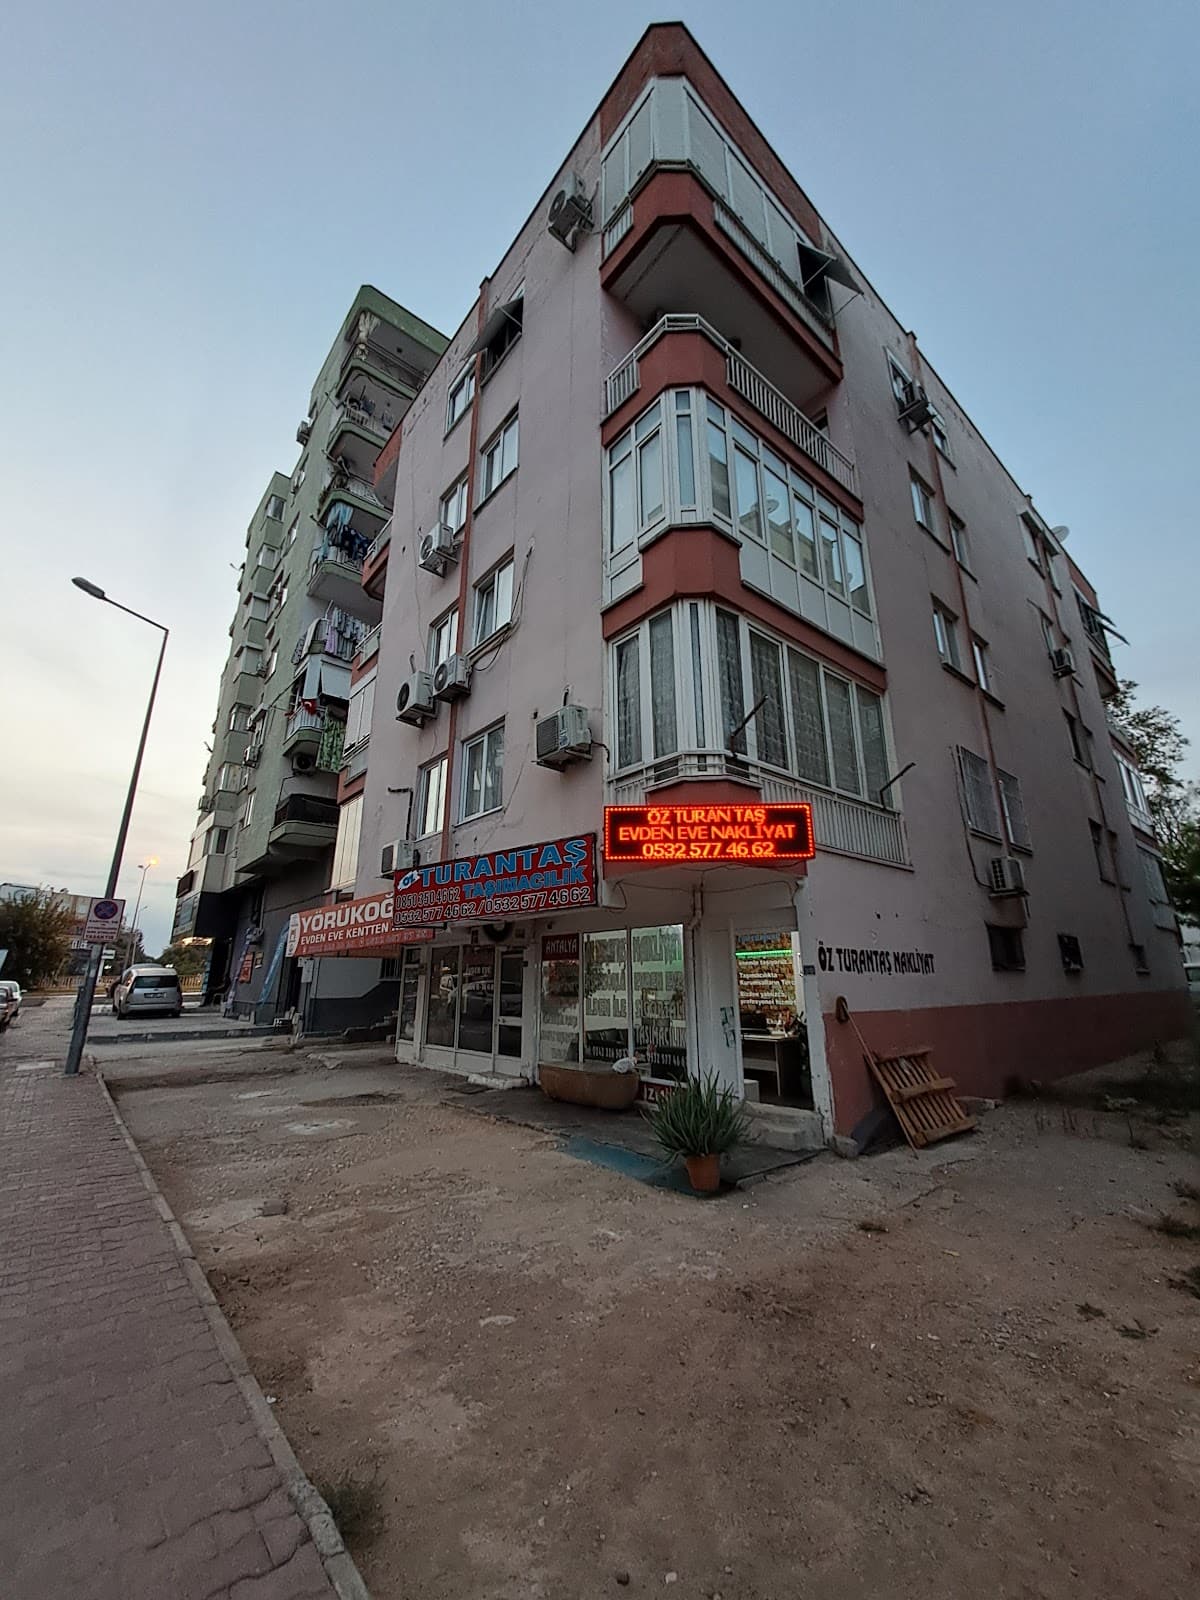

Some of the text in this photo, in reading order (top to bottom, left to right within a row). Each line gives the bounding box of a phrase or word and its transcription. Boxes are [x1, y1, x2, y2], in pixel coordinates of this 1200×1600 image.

[647, 807, 767, 825] ÖZ TURAN TAŞ
[618, 823, 796, 841] EVDEN EVE NAKLİYAT
[642, 841, 775, 858] 0532 577 46 62
[419, 839, 588, 888] TURANTAŞ
[462, 865, 588, 900] TAŞIMACILIK
[394, 909, 422, 924] 0532
[423, 905, 444, 921] 577
[485, 896, 520, 914] 0532
[520, 891, 548, 910] 577
[395, 892, 418, 910] 0850
[418, 890, 436, 907] 350
[300, 932, 326, 946] EVDEN
[328, 929, 344, 942] EVE
[346, 922, 389, 938] KENTTEN
[545, 938, 577, 954] ANTALYA
[817, 940, 935, 976] ÖZ TURANTAŞ NAKLİYAT
